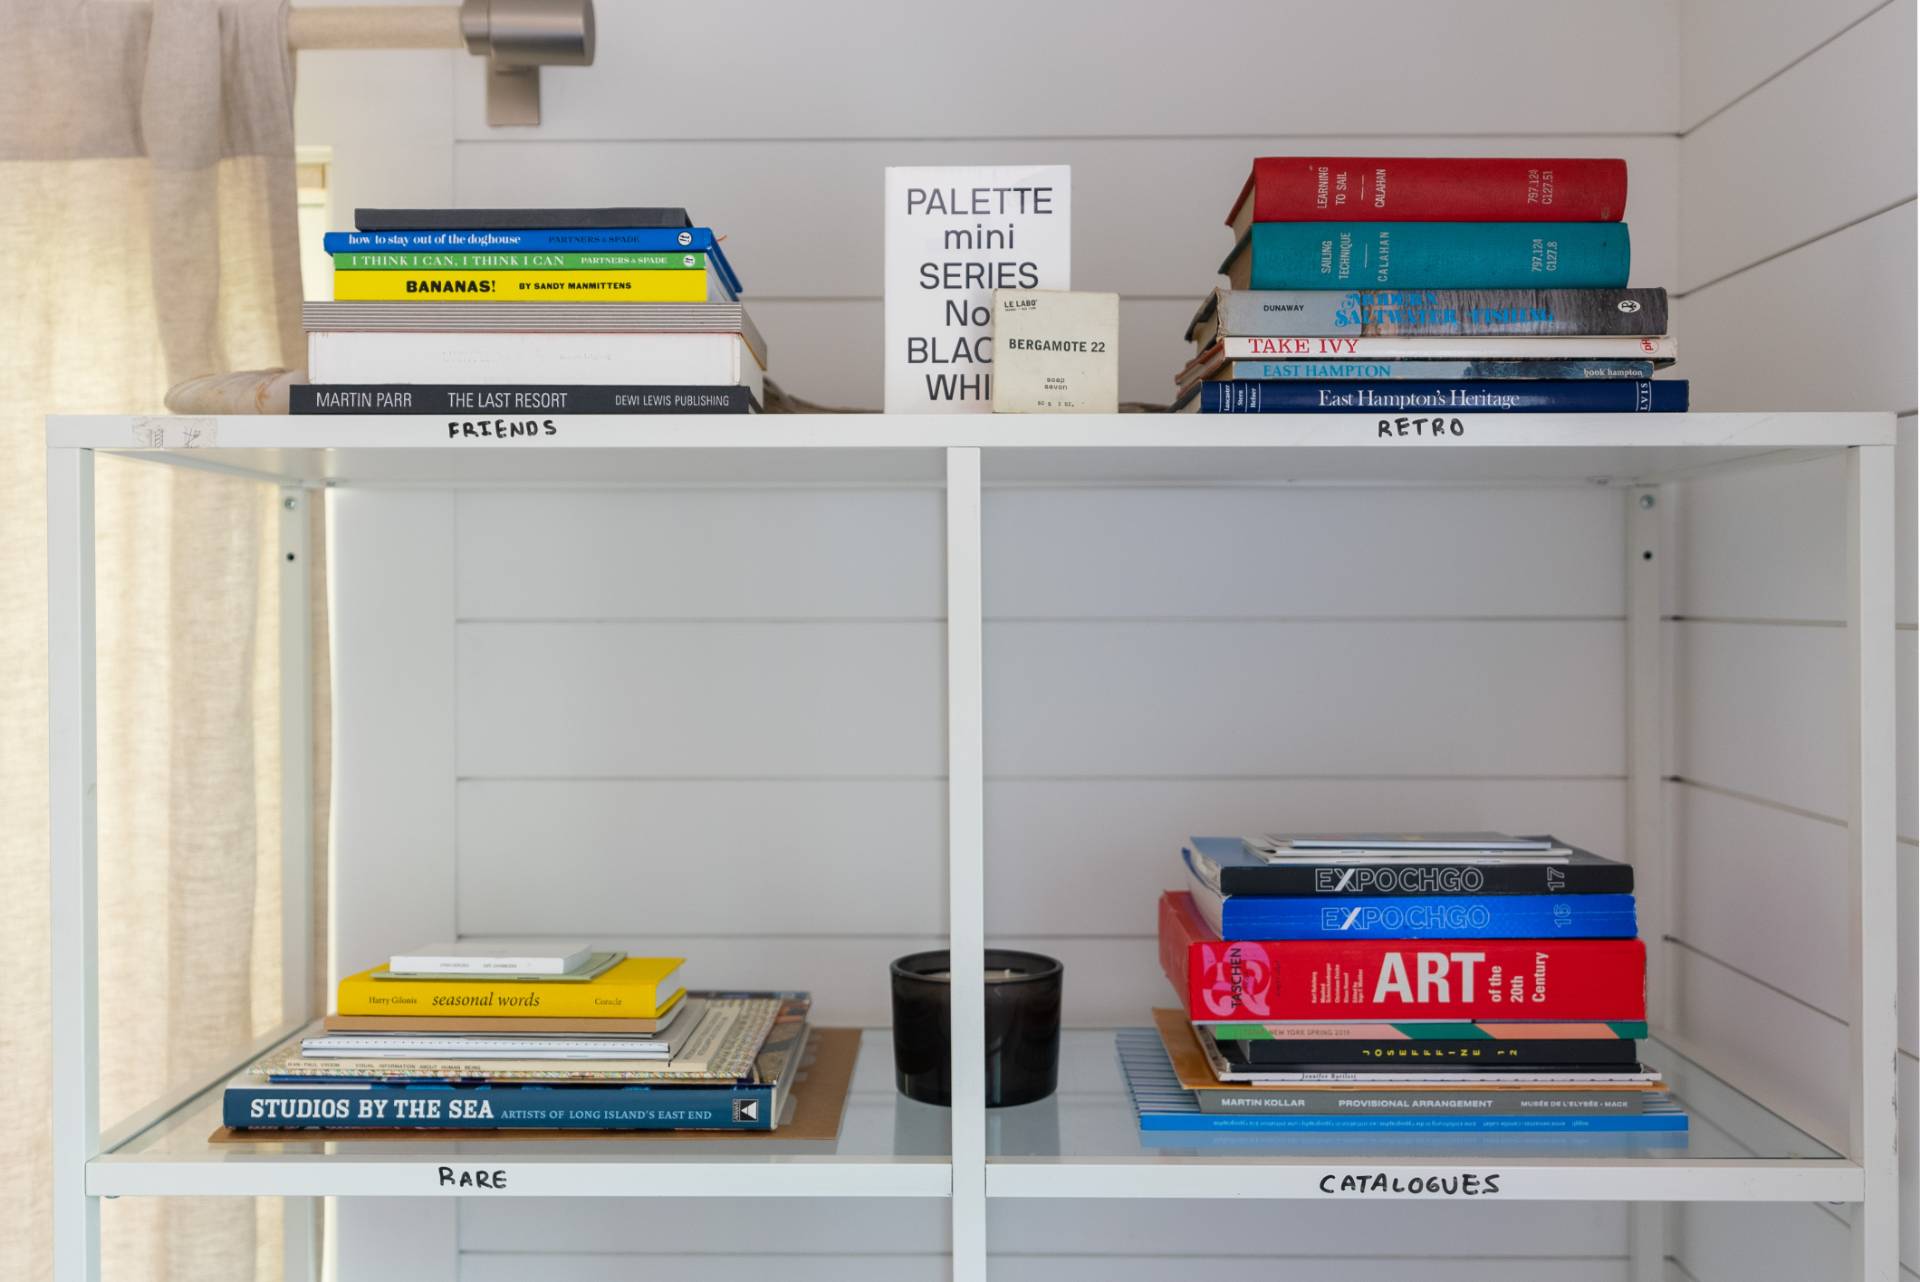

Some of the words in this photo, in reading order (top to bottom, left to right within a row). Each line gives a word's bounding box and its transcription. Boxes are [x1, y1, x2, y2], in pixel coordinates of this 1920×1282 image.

[1317, 166, 1329, 209] LEARNING
[1336, 171, 1347, 191] SAIL
[1374, 168, 1387, 208] CALAHAN
[1527, 169, 1539, 204] 797.124
[906, 187, 1054, 215] PALETTE
[1336, 193, 1346, 206] TO
[348, 233, 371, 245] how
[375, 233, 387, 245] to
[387, 234, 409, 247] stay
[412, 234, 432, 245] out
[434, 233, 447, 245] of
[448, 233, 466, 245] the
[467, 233, 521, 247] doghouse
[548, 235, 601, 244] PARTNERS
[607, 235, 640, 244] SPADE
[944, 223, 1015, 250] mini
[352, 256, 357, 266] I
[361, 256, 409, 266] THINK
[413, 256, 418, 266] I
[422, 256, 458, 267] CAN,
[463, 256, 468, 266] I
[472, 256, 519, 266] THINK
[523, 256, 529, 266] I
[533, 255, 565, 266] CAN
[580, 257, 630, 265] PARTNERS
[637, 257, 668, 265] SPADE
[1321, 240, 1333, 274] SAILING
[1338, 232, 1352, 280] TECHNIQUE
[1377, 231, 1390, 282] CALAHAN
[1531, 238, 1543, 272] 797.124
[405, 280, 496, 293] BANANAS!
[519, 282, 532, 290] BY
[534, 282, 565, 290] SANDY
[567, 282, 632, 290] MANMITTENS
[919, 262, 1039, 290] SERIES
[945, 299, 992, 327] No
[1003, 300, 1014, 309] LE
[1263, 303, 1304, 312] DUNAWAY
[907, 336, 993, 364] BLAC
[1008, 338, 1087, 353] BERGAMOTE
[1090, 341, 1106, 353] 22
[1248, 338, 1310, 354] TAKE
[1319, 337, 1360, 353] IVY
[1263, 365, 1301, 377] EAST
[1305, 365, 1392, 377] HAMPTON
[1583, 368, 1605, 378] book
[1607, 368, 1643, 378] hampton
[925, 373, 991, 401] WHI
[1639, 382, 1650, 411] LVIS
[316, 392, 372, 408] MARTIN
[376, 392, 412, 408] PARR
[447, 392, 473, 408] THE
[478, 392, 511, 408] LAST
[515, 392, 568, 408] RESORT
[615, 395, 640, 406] DEWI
[643, 395, 672, 406] LEWIS
[675, 395, 729, 407] PUBLISHING
[1319, 389, 1352, 407] East
[1357, 389, 1446, 410] Hampton's
[1450, 389, 1520, 410] Heritage
[447, 419, 557, 438] FRIENDS
[1377, 417, 1464, 438] RETRO
[1315, 866, 1484, 893] EXPOCHGO
[1546, 866, 1566, 892] 17
[1321, 904, 1490, 931] EXPOCHGO
[1553, 903, 1573, 928] 16
[1231, 947, 1242, 1009] TASCHEN
[1372, 952, 1486, 1004] ART
[1490, 965, 1502, 986] the
[1532, 951, 1550, 1003] Century
[431, 991, 494, 1007] seasonal
[497, 992, 540, 1007] words
[1488, 987, 1502, 1003] of
[1510, 974, 1524, 1003] 20th
[369, 996, 390, 1006] Harry
[250, 1098, 349, 1119] STUDIOS
[357, 1099, 389, 1119] BY
[393, 1099, 441, 1119] THE
[448, 1099, 495, 1119] SEA
[1220, 1098, 1263, 1107] MARTIN
[1264, 1098, 1306, 1107] KOLLAR
[1338, 1099, 1410, 1108] PROVISIONAL
[1411, 1099, 1494, 1108] ARRANGEMENT
[1550, 1100, 1561, 1108] DE
[1604, 1100, 1629, 1108] MACK
[500, 1110, 546, 1119] ARTISTS
[549, 1110, 565, 1119] OF
[569, 1110, 601, 1119] LONG
[604, 1110, 655, 1120] ISLAND'S
[658, 1110, 685, 1120] EAST
[687, 1110, 712, 1120] END
[437, 1166, 508, 1189] RARE
[1318, 1173, 1501, 1195] CATALOGUES
